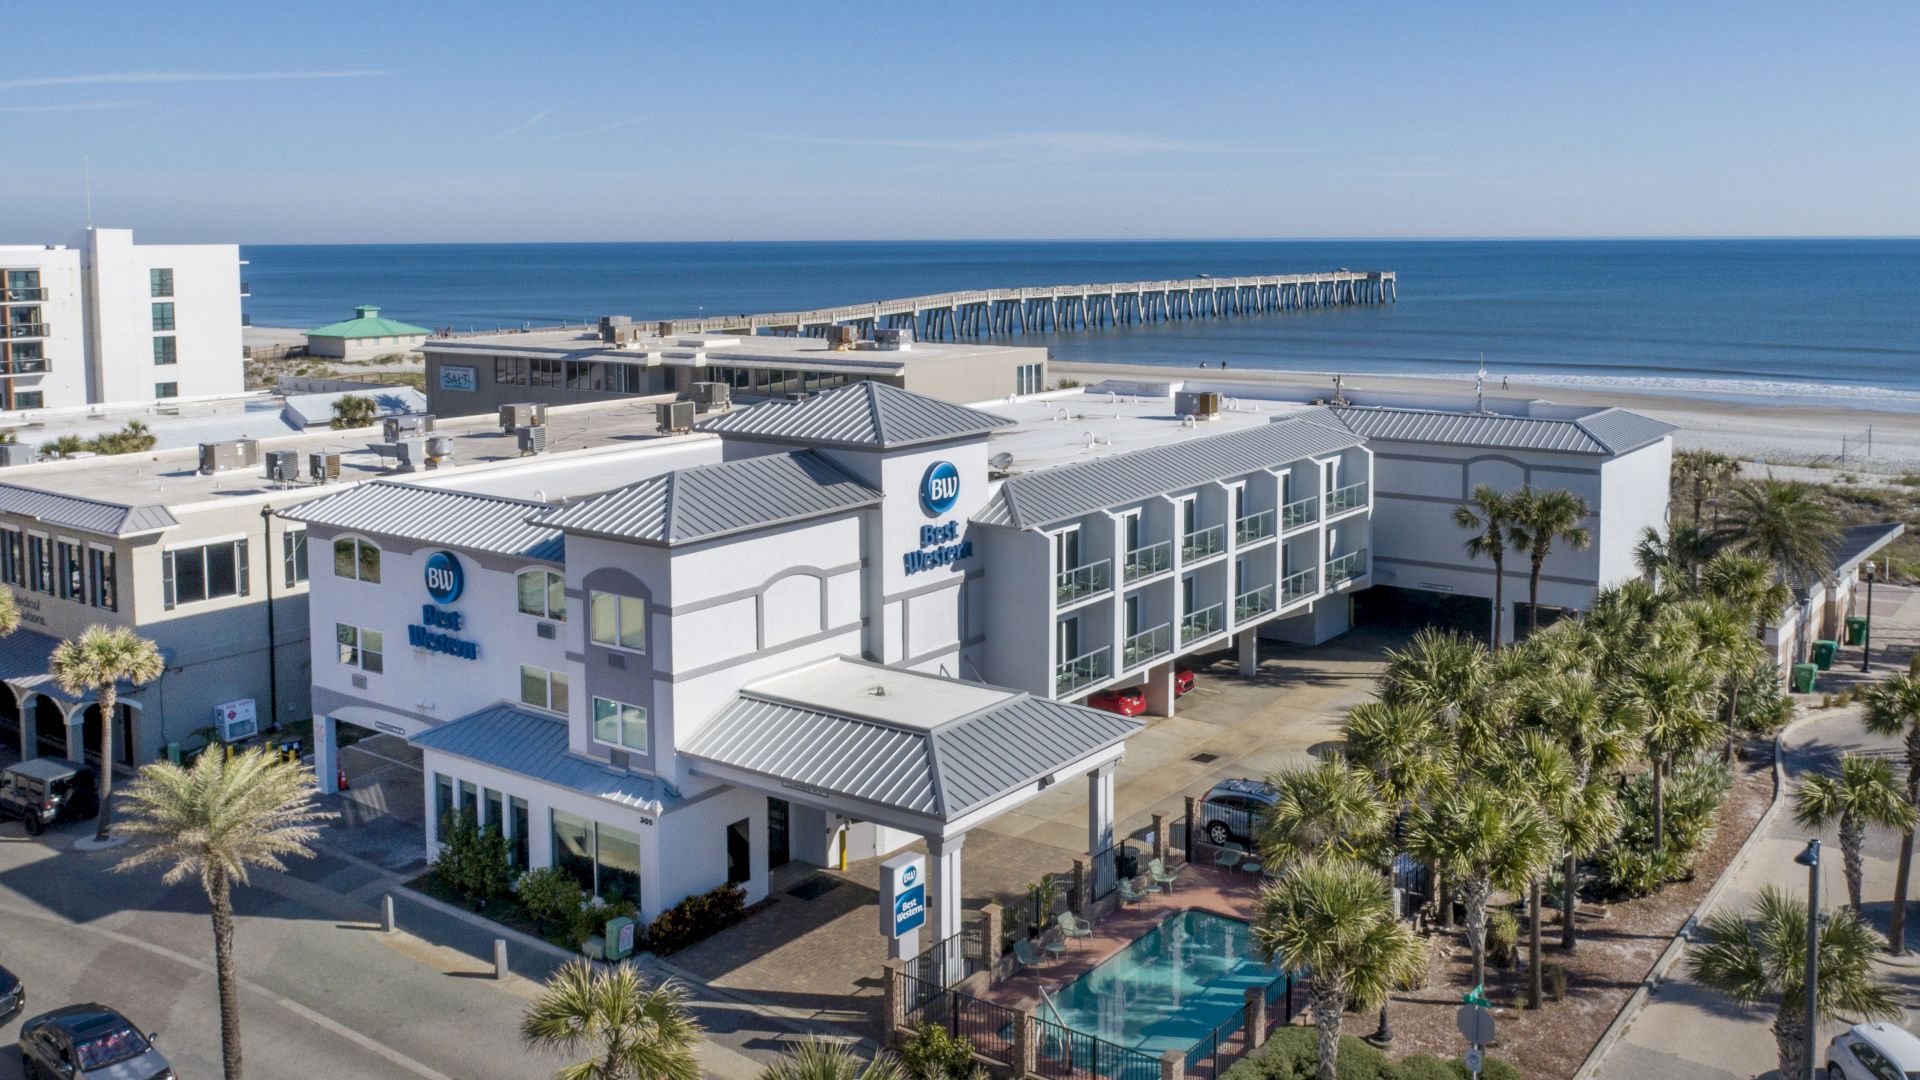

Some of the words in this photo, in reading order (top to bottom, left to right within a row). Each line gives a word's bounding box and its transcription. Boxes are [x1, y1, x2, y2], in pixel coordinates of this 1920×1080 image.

[446, 372, 469, 385] SALT
[931, 476, 957, 501] BW
[920, 520, 959, 549] Best
[903, 541, 973, 577] Western
[428, 567, 454, 591] BW
[422, 604, 463, 632] Best
[407, 624, 478, 661] Western
[640, 816, 653, 826] 305
[903, 869, 916, 884] BW
[896, 904, 924, 923] Western
[902, 898, 917, 912] Best
